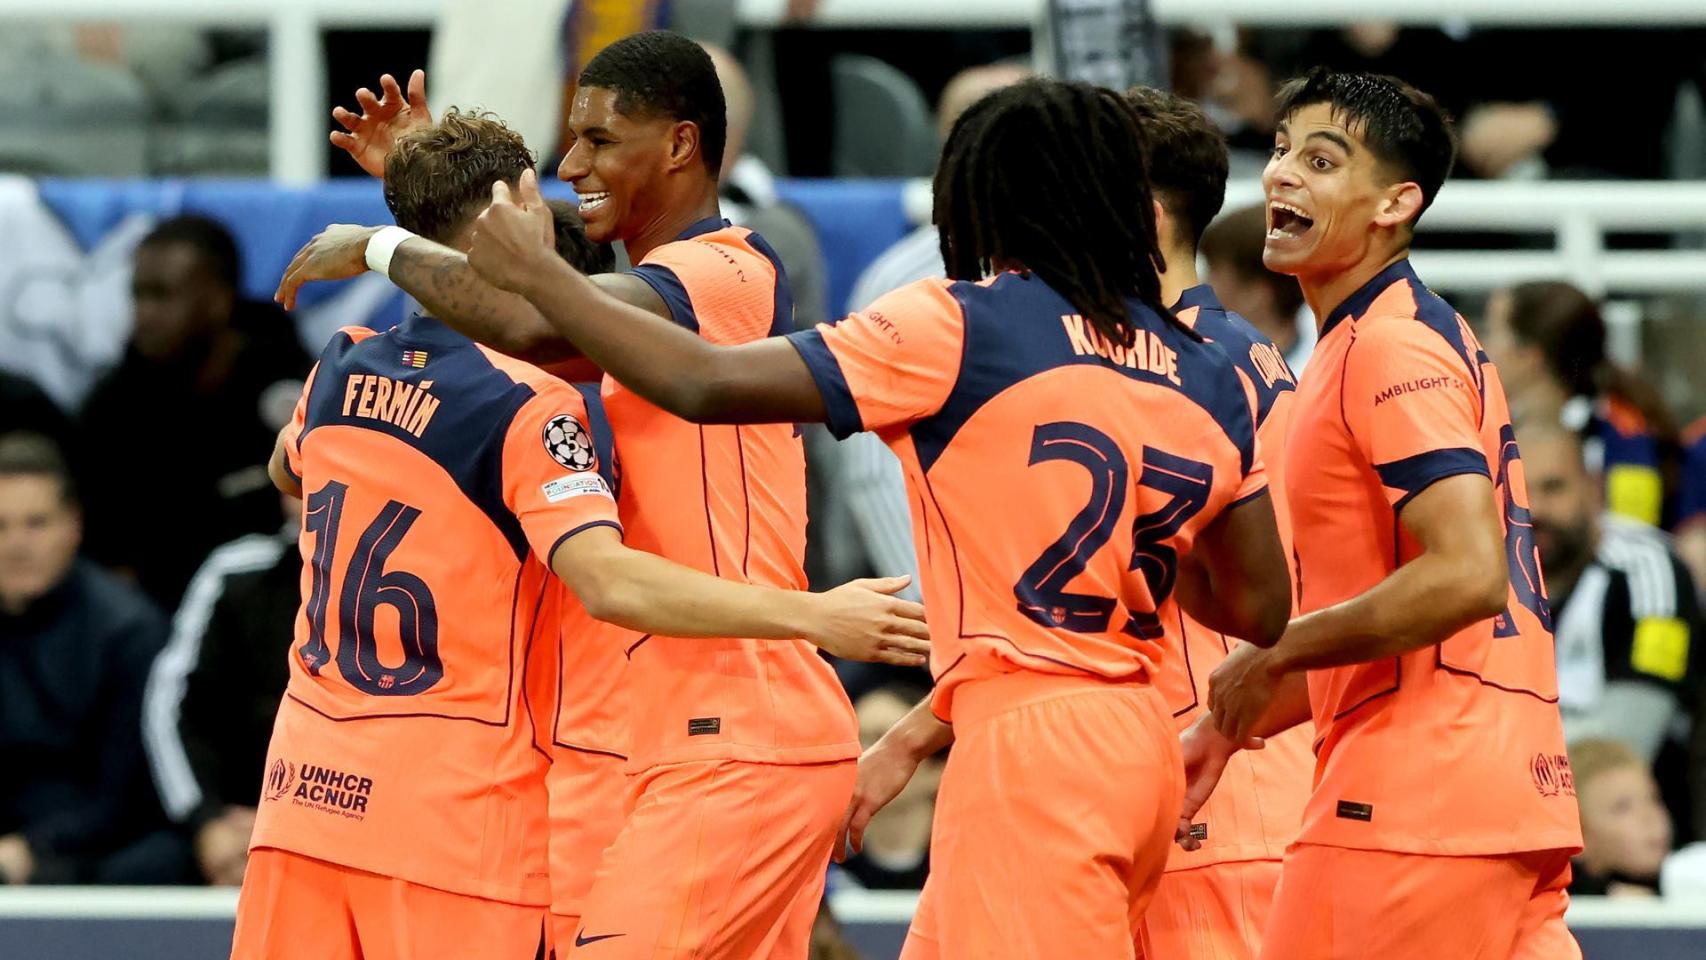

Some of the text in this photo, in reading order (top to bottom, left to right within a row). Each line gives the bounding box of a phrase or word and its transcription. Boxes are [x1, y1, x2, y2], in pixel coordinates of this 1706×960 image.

[342, 374, 440, 438] FERMÍN
[1374, 377, 1449, 407] AMBILIGHT
[564, 432, 580, 454] 5
[1013, 421, 1214, 640] 23
[298, 479, 444, 697] 16
[299, 763, 373, 796] UNHCR
[294, 782, 368, 813] ACNUR
